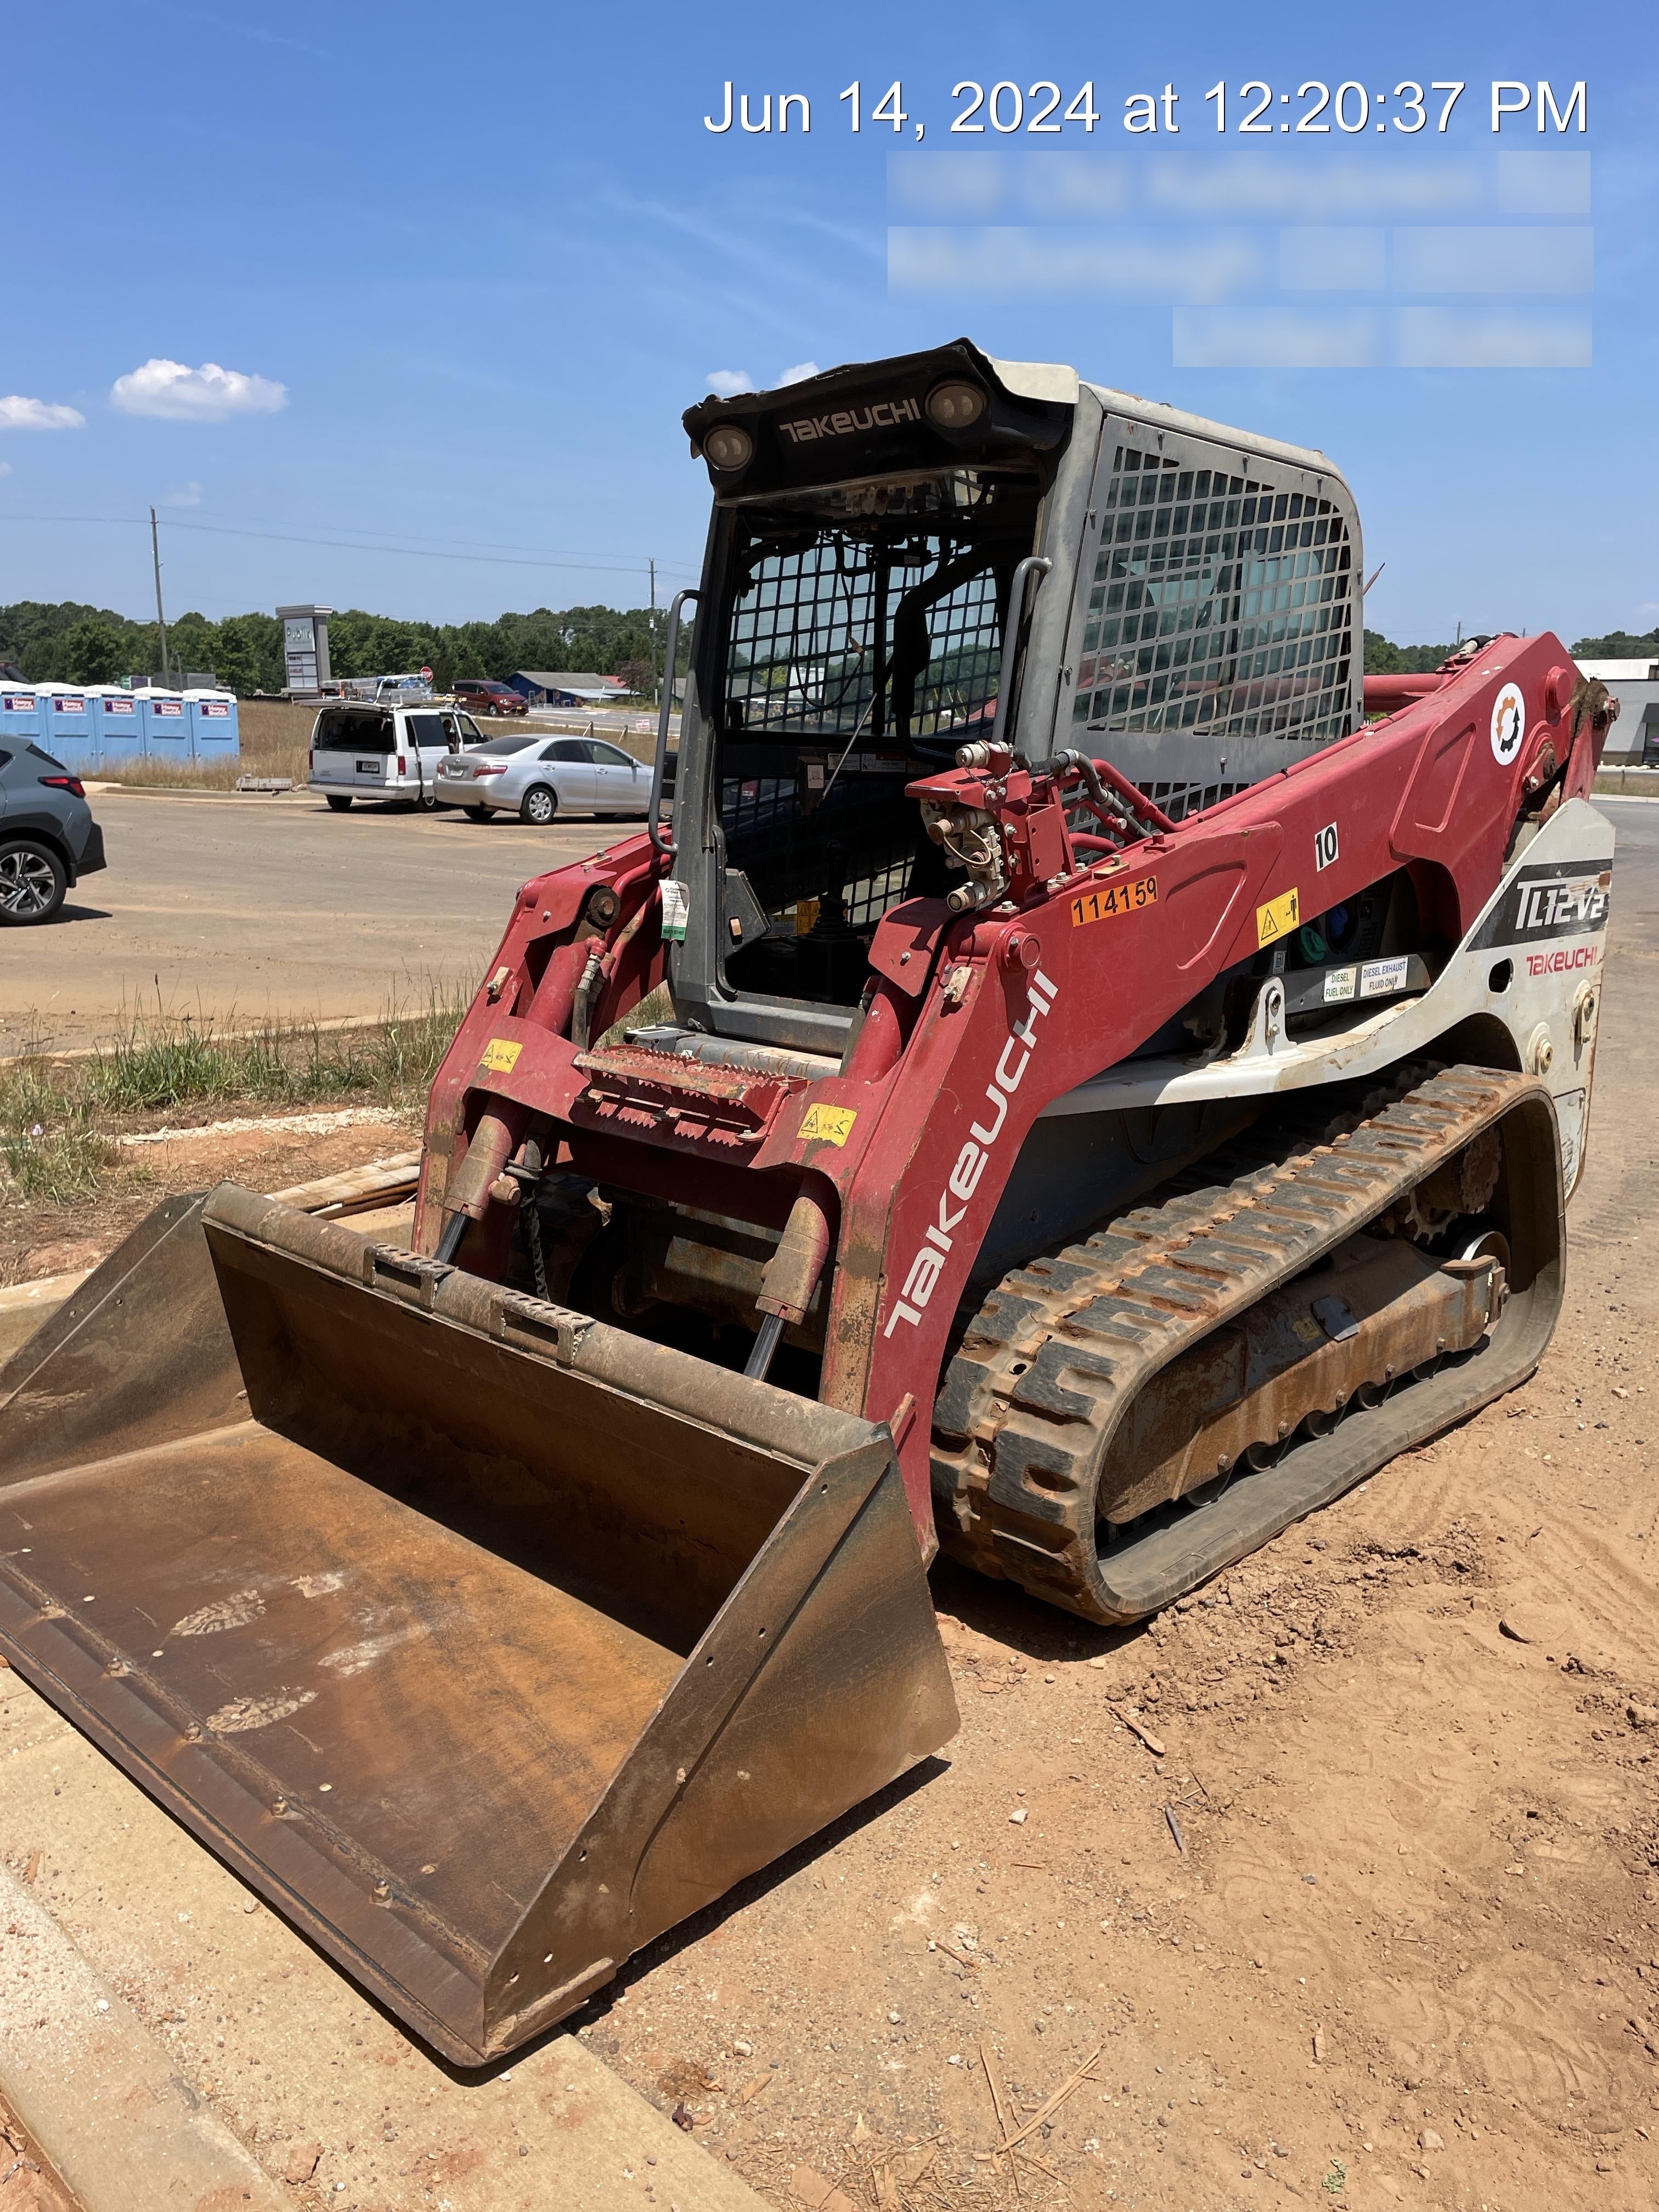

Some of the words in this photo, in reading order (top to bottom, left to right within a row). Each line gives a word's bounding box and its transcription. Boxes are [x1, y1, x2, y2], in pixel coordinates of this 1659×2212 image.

[780, 398, 921, 442] TAKEUCHI
[1316, 826, 1337, 868] 10
[1073, 877, 1157, 923] 114159
[1363, 967, 1381, 979] DIESEL
[1382, 961, 1406, 974] EXHAUST
[1526, 945, 1598, 977] TAKEUCHI
[1325, 988, 1339, 997] FUEL
[1340, 985, 1353, 996] ONLY
[1331, 973, 1350, 984] DIESEL
[1369, 979, 1384, 991] FLUID
[1385, 975, 1399, 988] ONLY
[883, 969, 1059, 1339] TAKEUCHI
